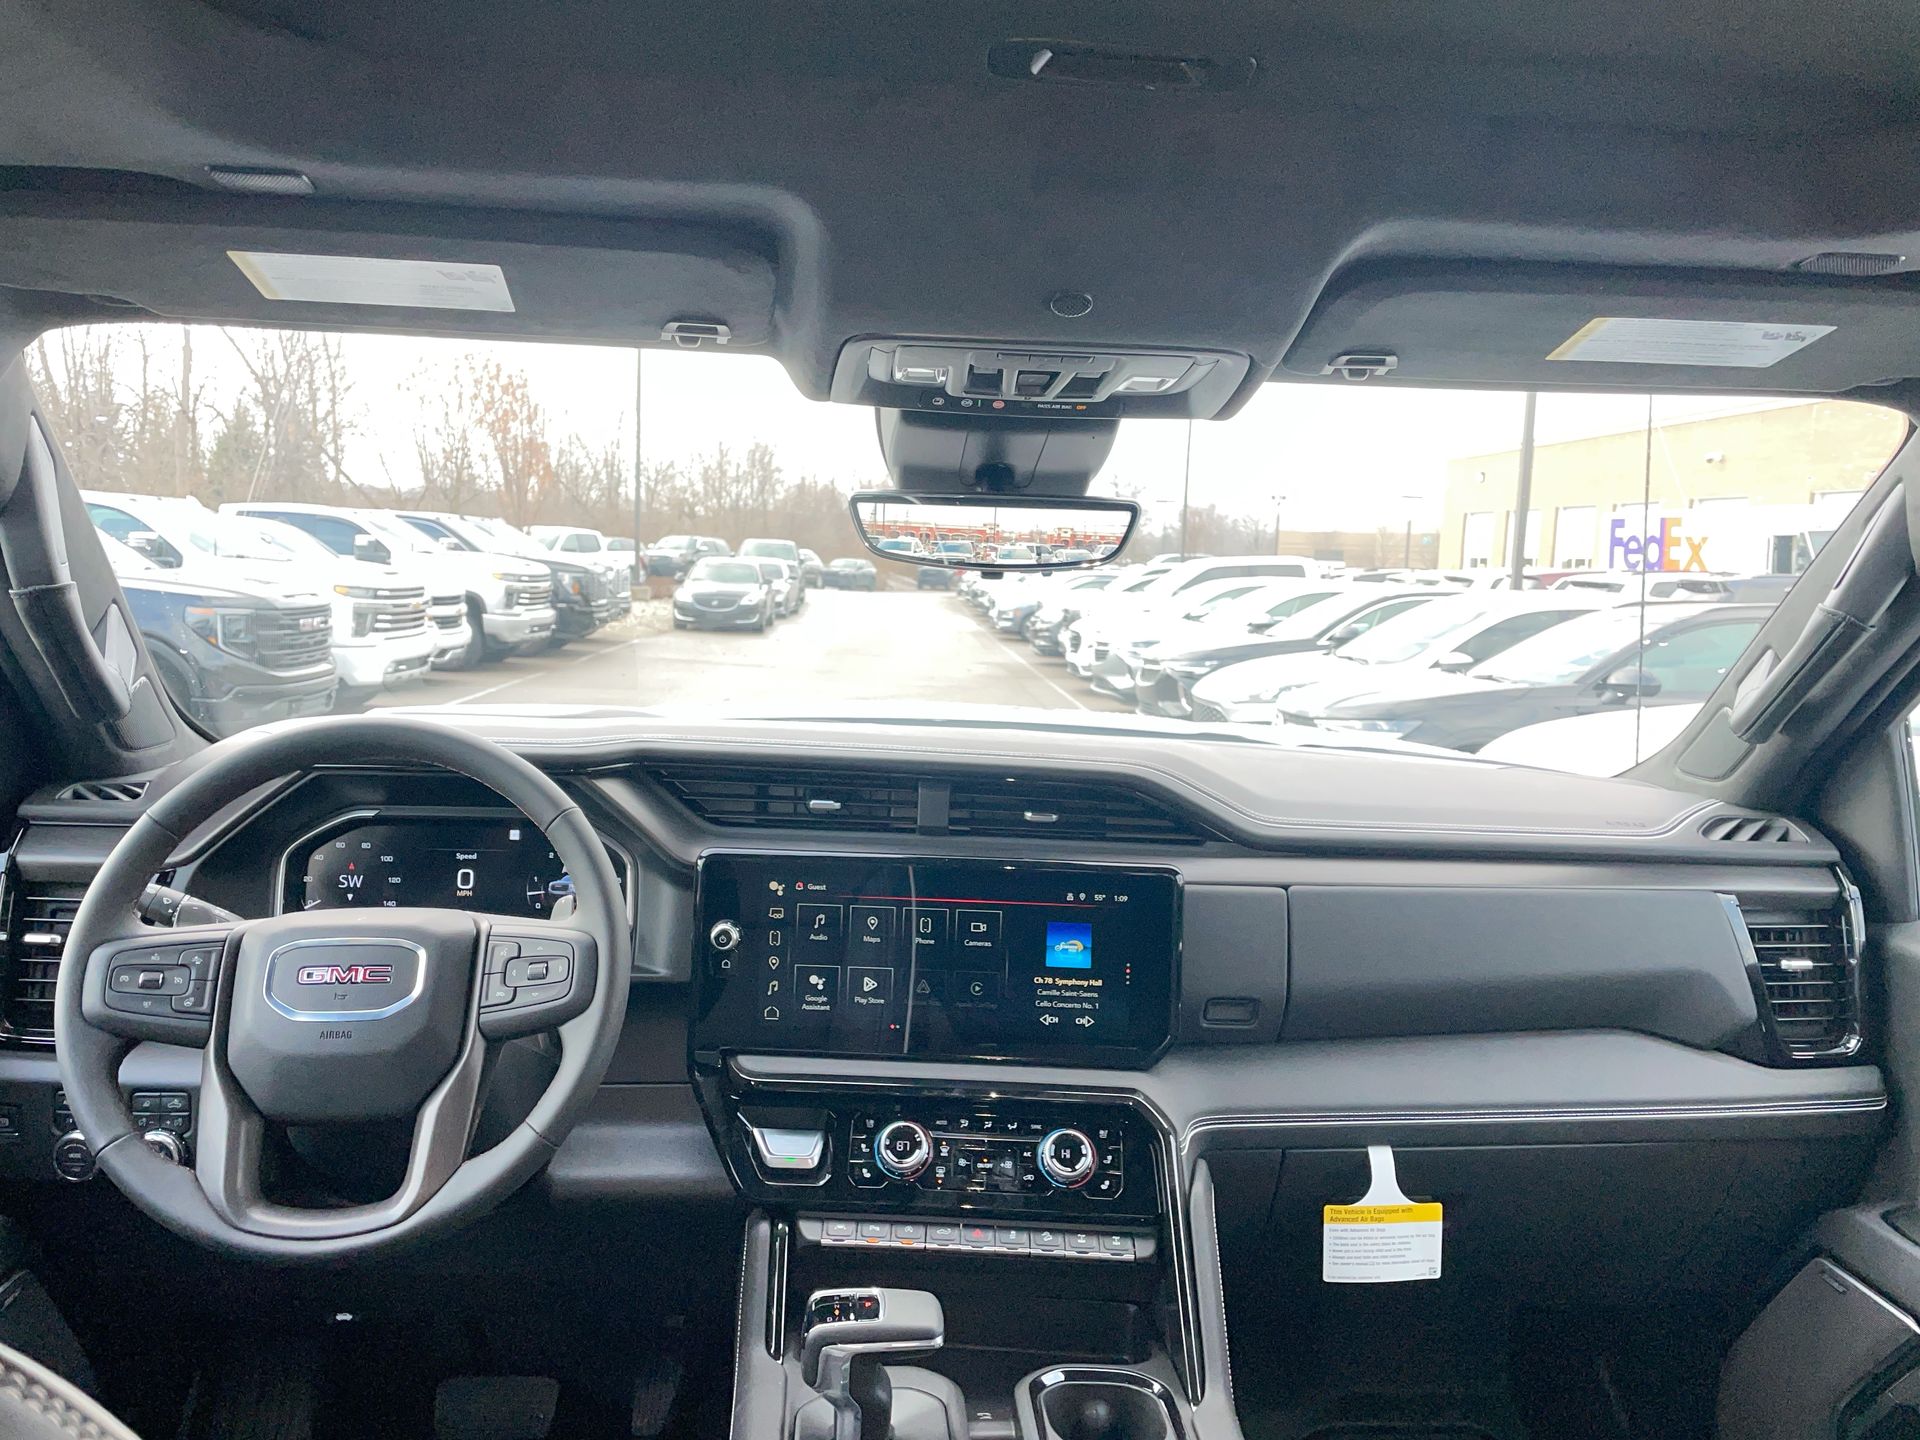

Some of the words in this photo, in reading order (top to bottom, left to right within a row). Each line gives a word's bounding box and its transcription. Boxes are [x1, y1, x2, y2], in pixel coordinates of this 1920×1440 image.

[1608, 517, 1708, 573] FedEx
[455, 852, 477, 860] Speed
[338, 874, 364, 888] SW
[456, 868, 475, 890] 0
[807, 883, 827, 891] Guest
[456, 889, 473, 897] MPH
[809, 933, 828, 941] Audio
[863, 935, 881, 943] Maps
[915, 937, 935, 945] Phone
[964, 939, 992, 947] Cameras
[297, 965, 393, 985] GMC
[1055, 977, 1089, 987] Symphony
[1037, 988, 1060, 996] Camille
[804, 994, 828, 1002] Google
[854, 996, 867, 1004] Play
[801, 1003, 831, 1011] Assistant
[1053, 1001, 1081, 1009] Concerto
[319, 1030, 353, 1040] AIRBAG
[1373, 1208, 1399, 1216] Equipped
[1329, 1215, 1359, 1223] Advanced
[1370, 1215, 1384, 1224] Bags
